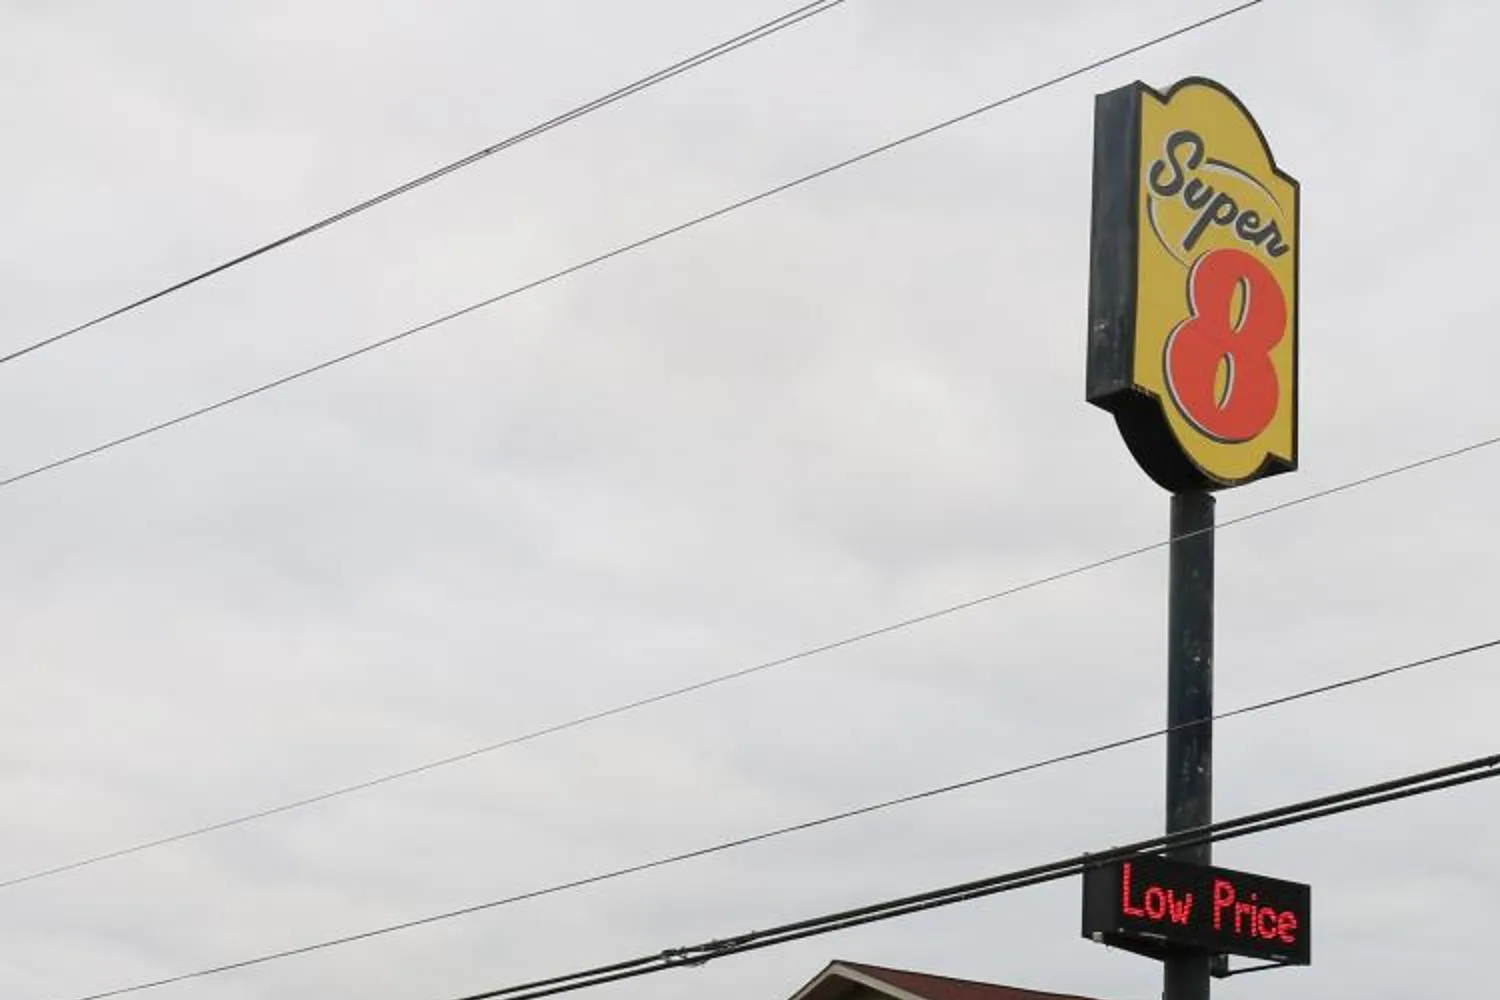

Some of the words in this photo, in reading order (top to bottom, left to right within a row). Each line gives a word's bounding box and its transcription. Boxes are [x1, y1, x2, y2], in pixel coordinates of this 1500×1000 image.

[1148, 129, 1290, 259] Super
[1163, 247, 1287, 444] 8
[1121, 862, 1195, 925] Low
[1212, 877, 1298, 944] Price
